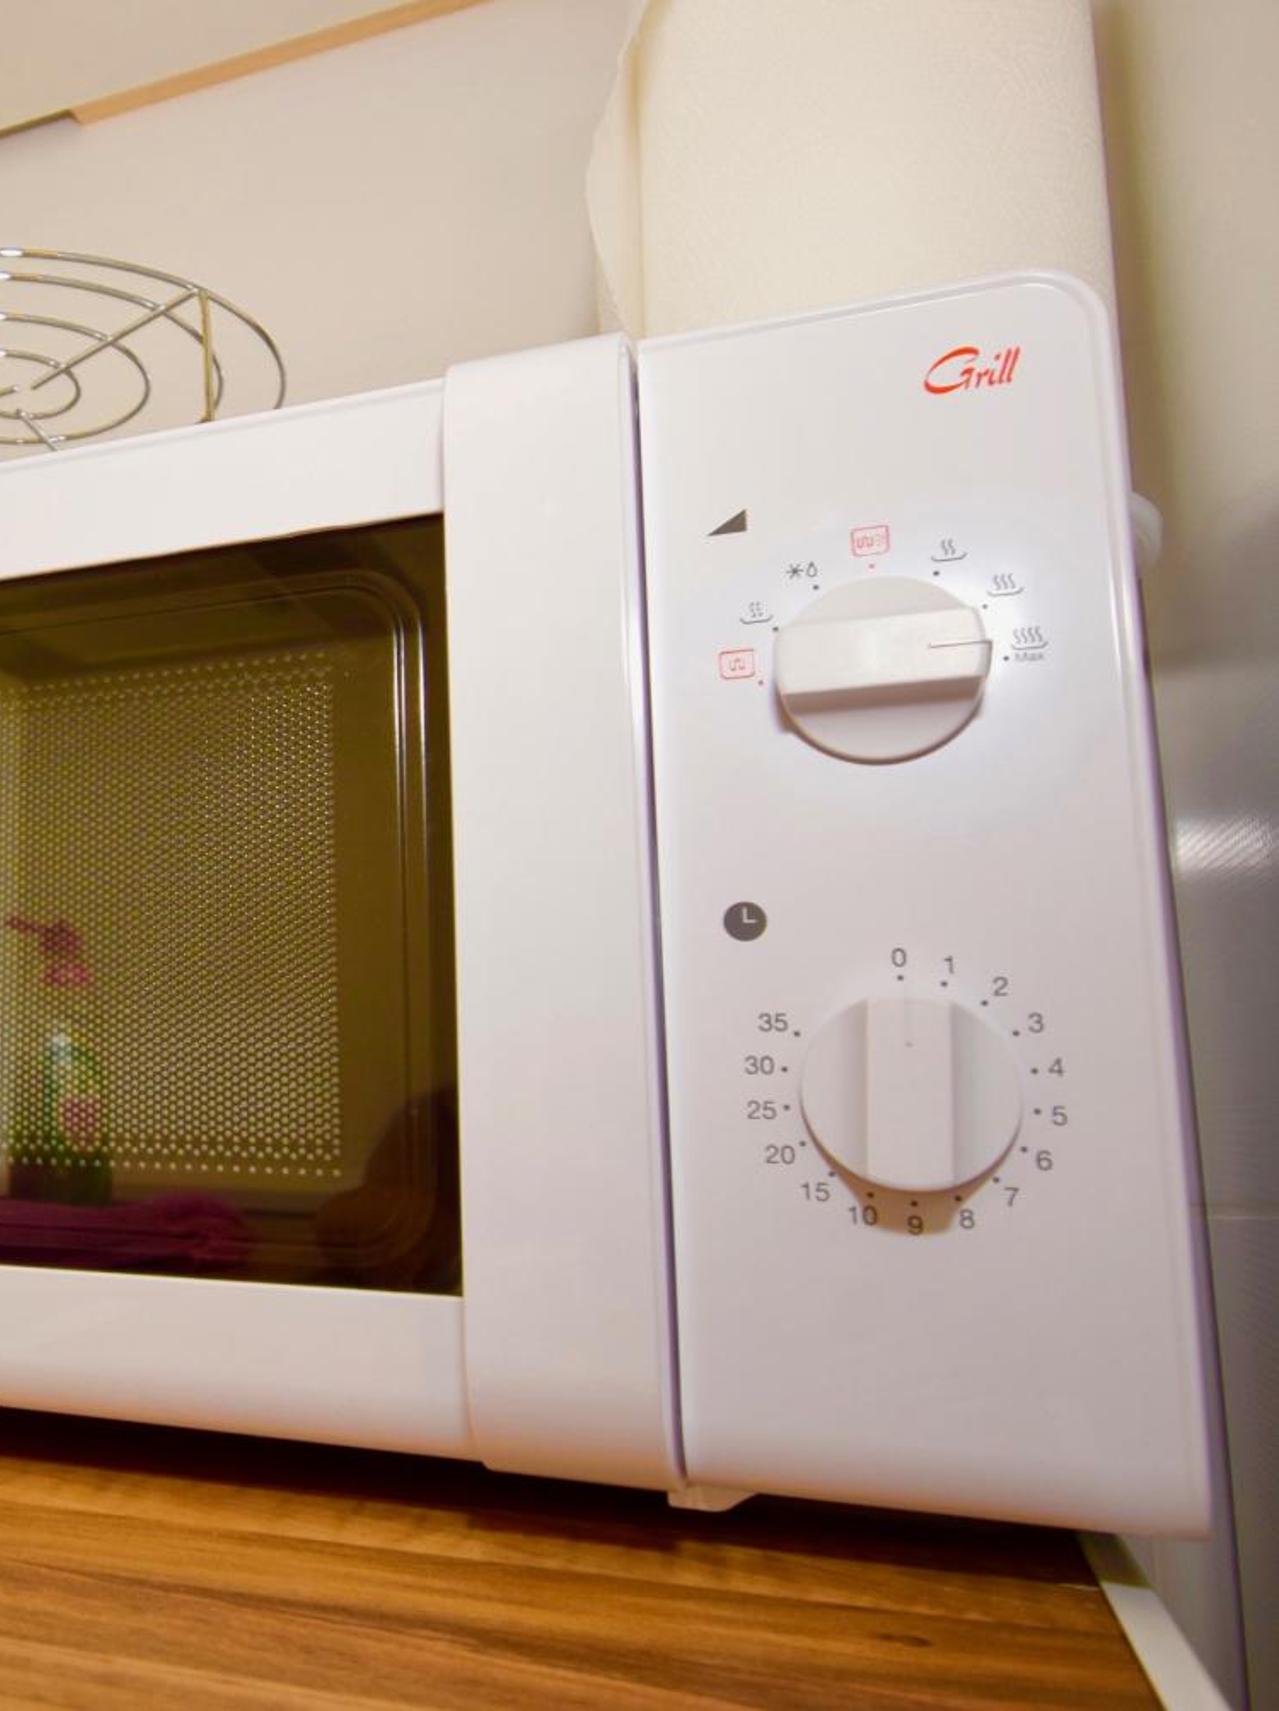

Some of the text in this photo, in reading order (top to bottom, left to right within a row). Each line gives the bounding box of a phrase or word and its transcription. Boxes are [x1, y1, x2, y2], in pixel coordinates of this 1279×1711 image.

[924, 347, 1020, 394] Grill
[892, 948, 906, 967] 0
[943, 956, 955, 974] 1
[993, 977, 1008, 996] 2
[759, 1013, 788, 1032] 35
[1029, 1012, 1044, 1033] 3
[745, 1056, 774, 1075] 30
[1048, 1058, 1064, 1076] 4
[748, 1100, 776, 1119] 25
[1052, 1106, 1067, 1126] 5
[766, 1144, 795, 1164] 20
[1036, 1150, 1052, 1171] 6
[801, 1182, 830, 1202] 15
[1004, 1187, 1020, 1206] 7
[849, 1206, 878, 1226] 10
[908, 1215, 923, 1234] 9
[959, 1208, 975, 1229] 8
